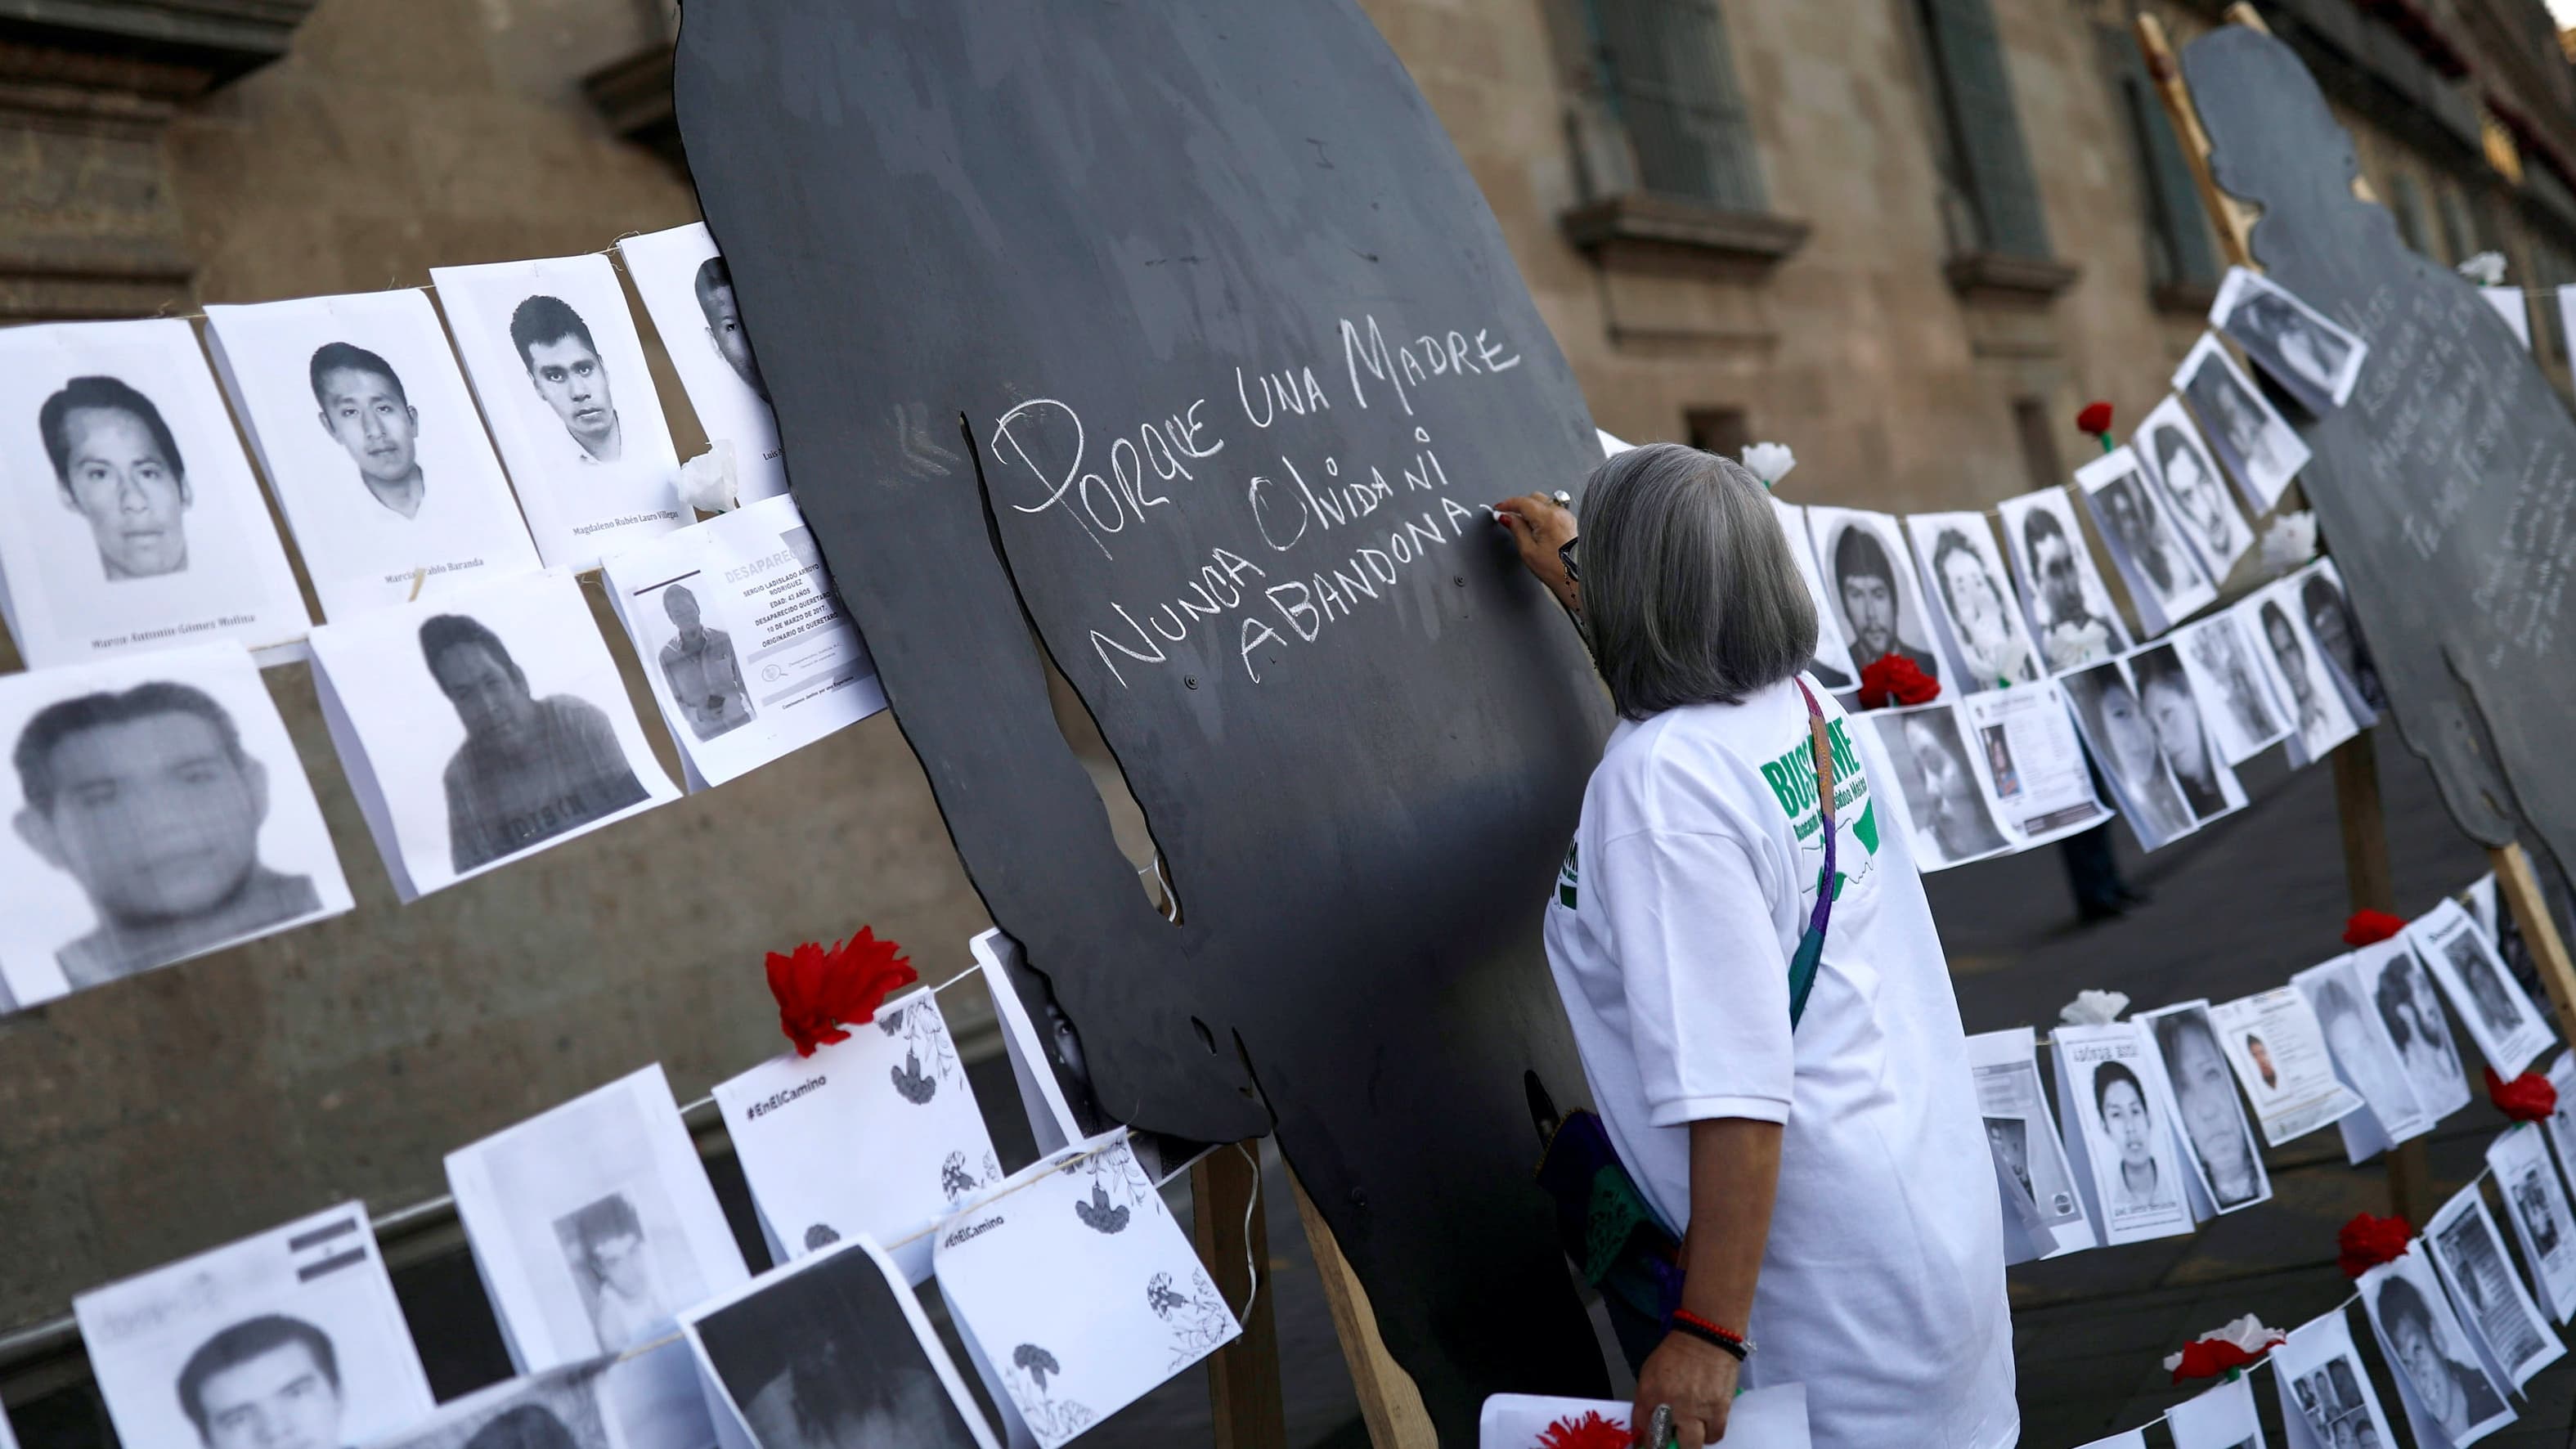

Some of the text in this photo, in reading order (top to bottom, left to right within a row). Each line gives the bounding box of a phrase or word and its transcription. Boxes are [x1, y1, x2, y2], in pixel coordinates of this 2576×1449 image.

[990, 314, 1522, 561] PORQUE UNA MADRE
[762, 450, 778, 460] Luis
[572, 509, 679, 536] Magdaleno Rubén Lauro Villegas
[384, 557, 484, 584] Marcia ablo Baranda
[743, 562, 819, 597] SERGIO LADISLADO ARROYO
[769, 577, 803, 596] RODRIGUEZ
[770, 597, 788, 608] EDAD:
[796, 587, 811, 599] AÑOS
[1241, 496, 1472, 684] ABANDONA
[754, 604, 798, 626] DESAPARECIDO
[775, 622, 783, 630] DE
[783, 614, 805, 628] MARZO
[804, 611, 812, 619] DE
[1089, 548, 1266, 689] NUNCA
[130, 627, 175, 643] Antonio
[761, 629, 797, 648] ORIGINARIO
[797, 625, 806, 634] DE
[1759, 716, 1860, 819] BUSCME
[747, 1074, 826, 1121] #EnElCamino
